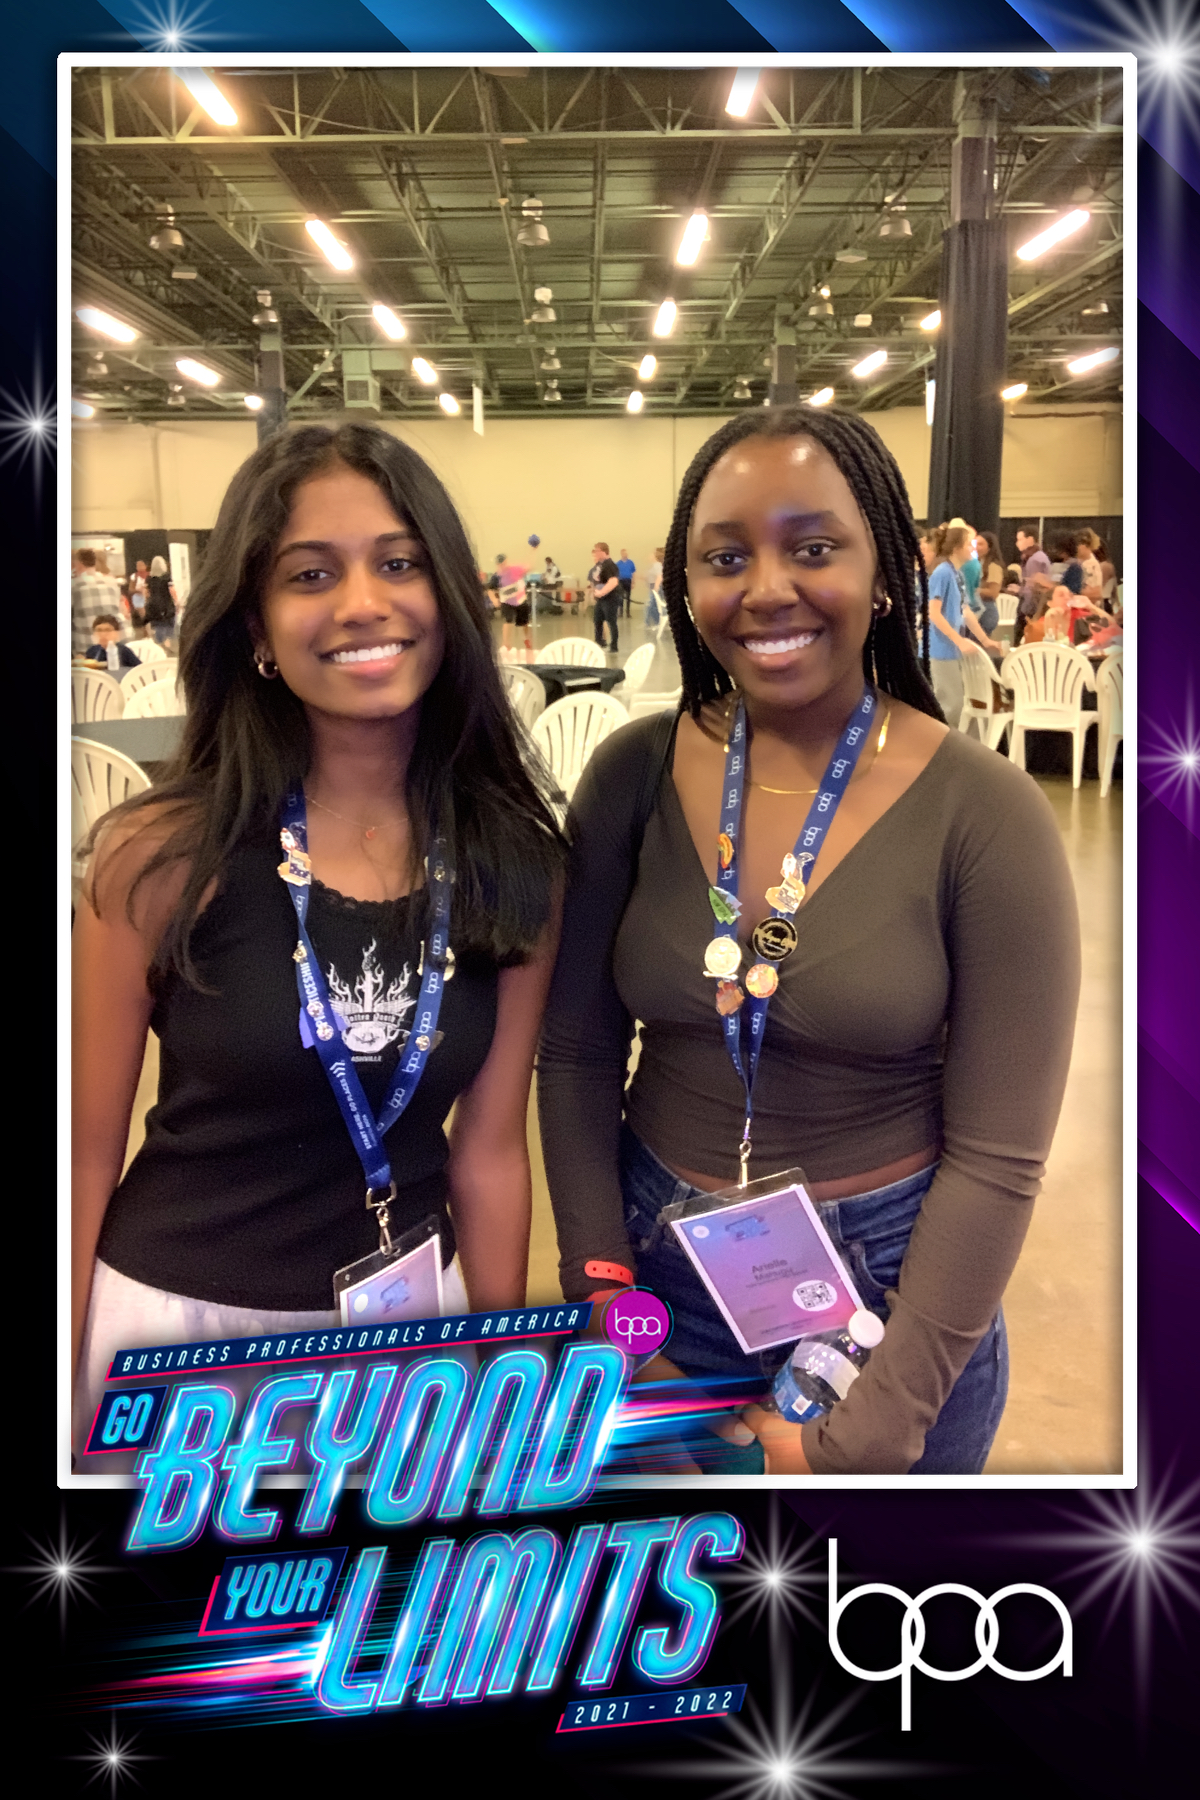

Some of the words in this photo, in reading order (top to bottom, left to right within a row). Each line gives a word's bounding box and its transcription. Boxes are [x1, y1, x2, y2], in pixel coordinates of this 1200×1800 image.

[732, 723, 745, 743] bpa
[846, 726, 864, 746] bpa
[728, 755, 742, 776] bpa
[831, 758, 851, 779] bpa
[725, 789, 739, 809] bpa
[818, 792, 837, 812] bpa
[725, 822, 736, 839] pa
[803, 826, 823, 847] bpa
[431, 934, 443, 956] bpa
[425, 971, 440, 994] bpa
[416, 1011, 433, 1034] bpa
[751, 1012, 763, 1035] bpa
[402, 1051, 421, 1073] bpa
[388, 1087, 406, 1109] bpa
